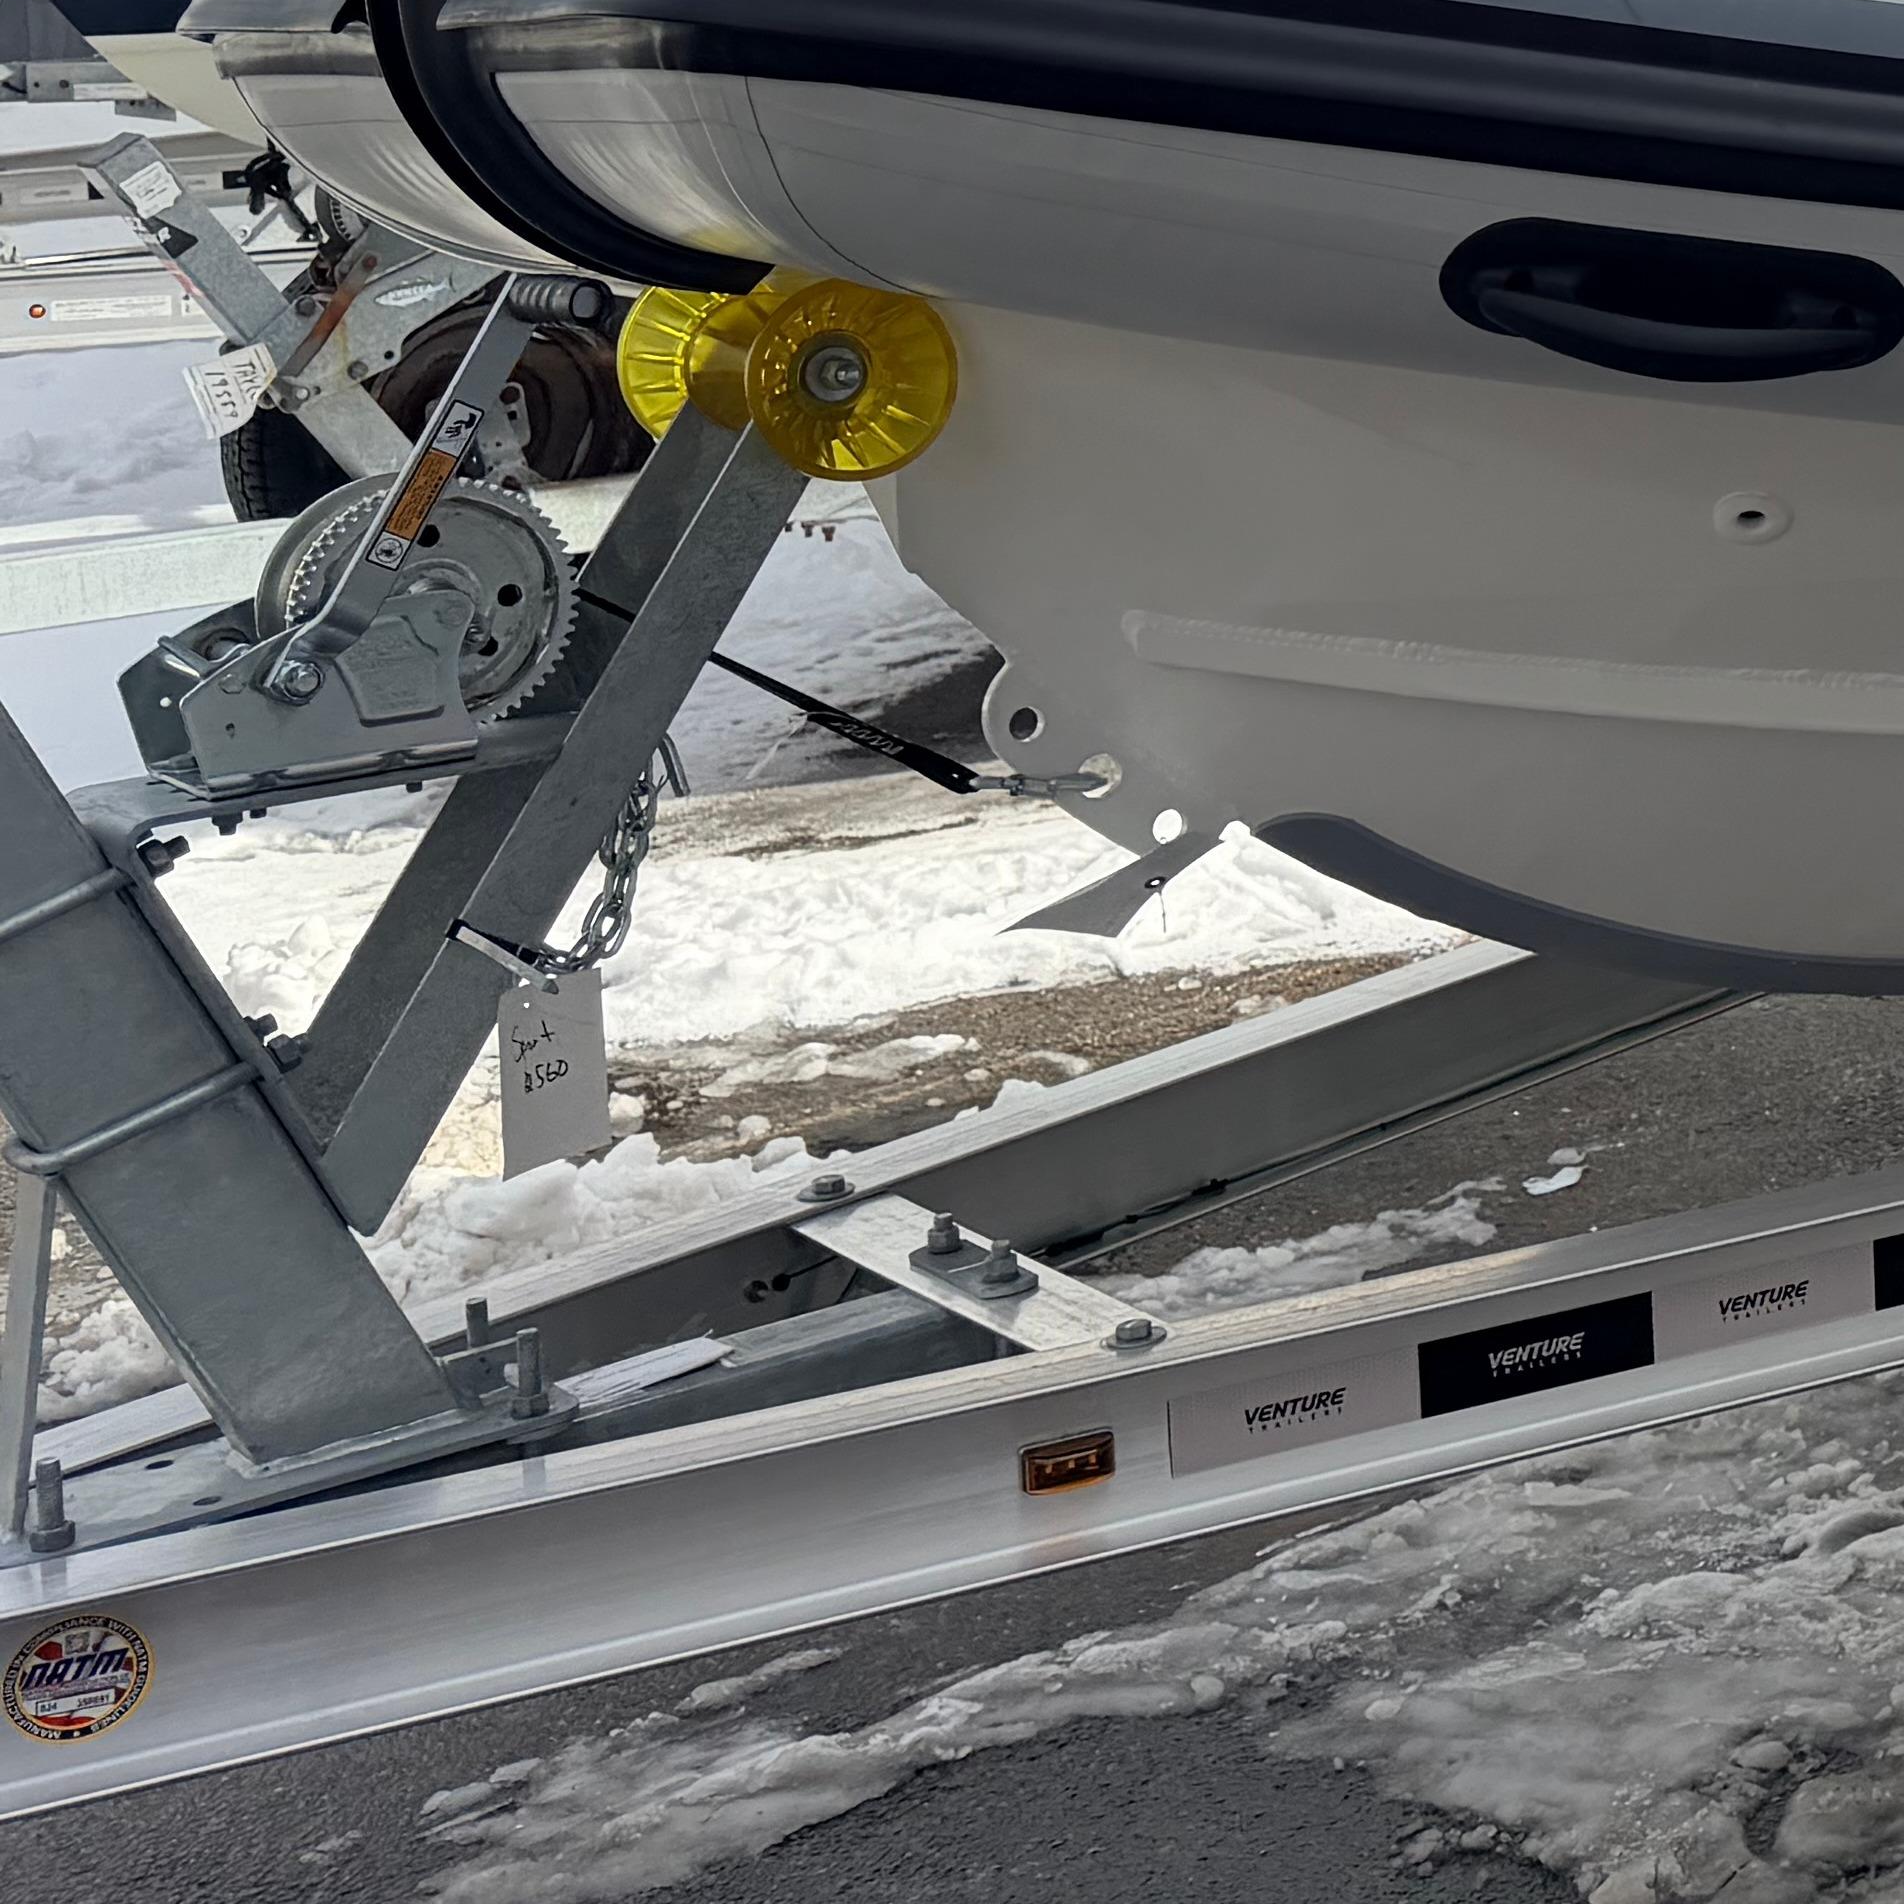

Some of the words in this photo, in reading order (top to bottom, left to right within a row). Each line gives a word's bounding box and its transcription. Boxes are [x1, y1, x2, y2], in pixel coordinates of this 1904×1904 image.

[1718, 1279, 1809, 1315] VENTURE
[1488, 1331, 1585, 1370] VENTURE
[1244, 1386, 1346, 1425] VENTURE
